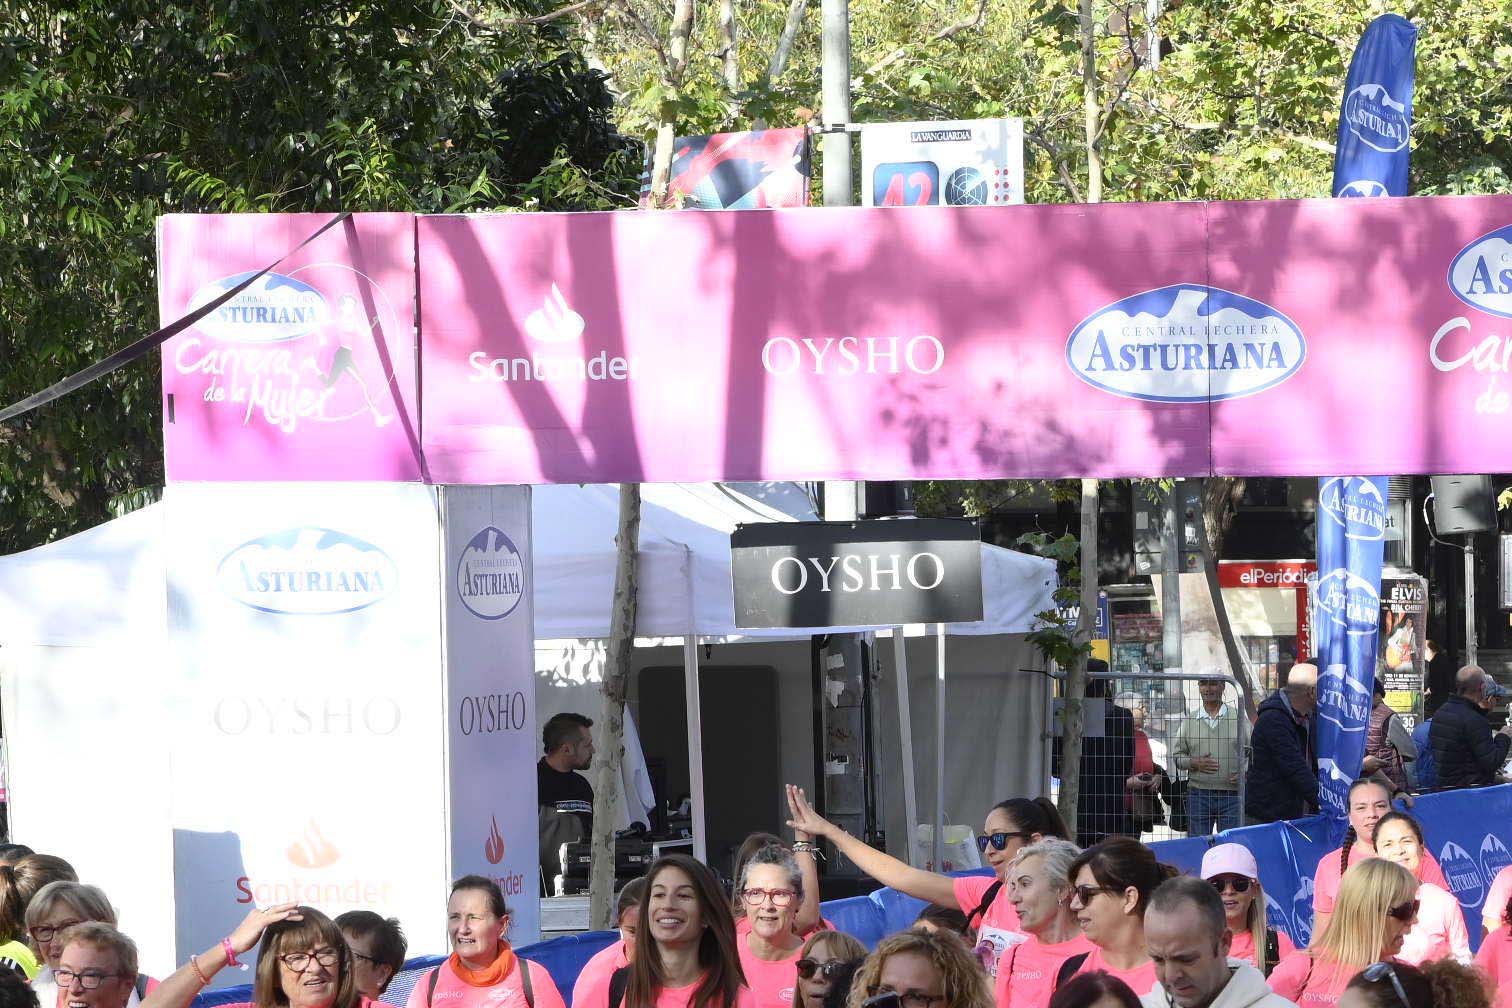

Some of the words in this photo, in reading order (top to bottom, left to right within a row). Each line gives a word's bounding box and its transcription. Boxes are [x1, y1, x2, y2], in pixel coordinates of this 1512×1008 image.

[1121, 325, 1197, 337] CENTRAL
[1204, 323, 1279, 337] LECHERA
[175, 338, 293, 375] Carrera
[469, 351, 641, 383] Santander
[761, 334, 945, 375] OYSHO
[1084, 336, 1288, 373] ASTURIANA
[243, 372, 337, 433] Mujer
[1475, 375, 1509, 414] de
[241, 559, 385, 593] ASTURIANA
[463, 561, 521, 598] ASTURIANA
[771, 551, 945, 595] OYSHO
[1240, 567, 1308, 585] elPeriódi
[1391, 587, 1422, 600] ELVIS
[214, 695, 402, 736] OYSHO
[460, 690, 526, 736] OYSHO
